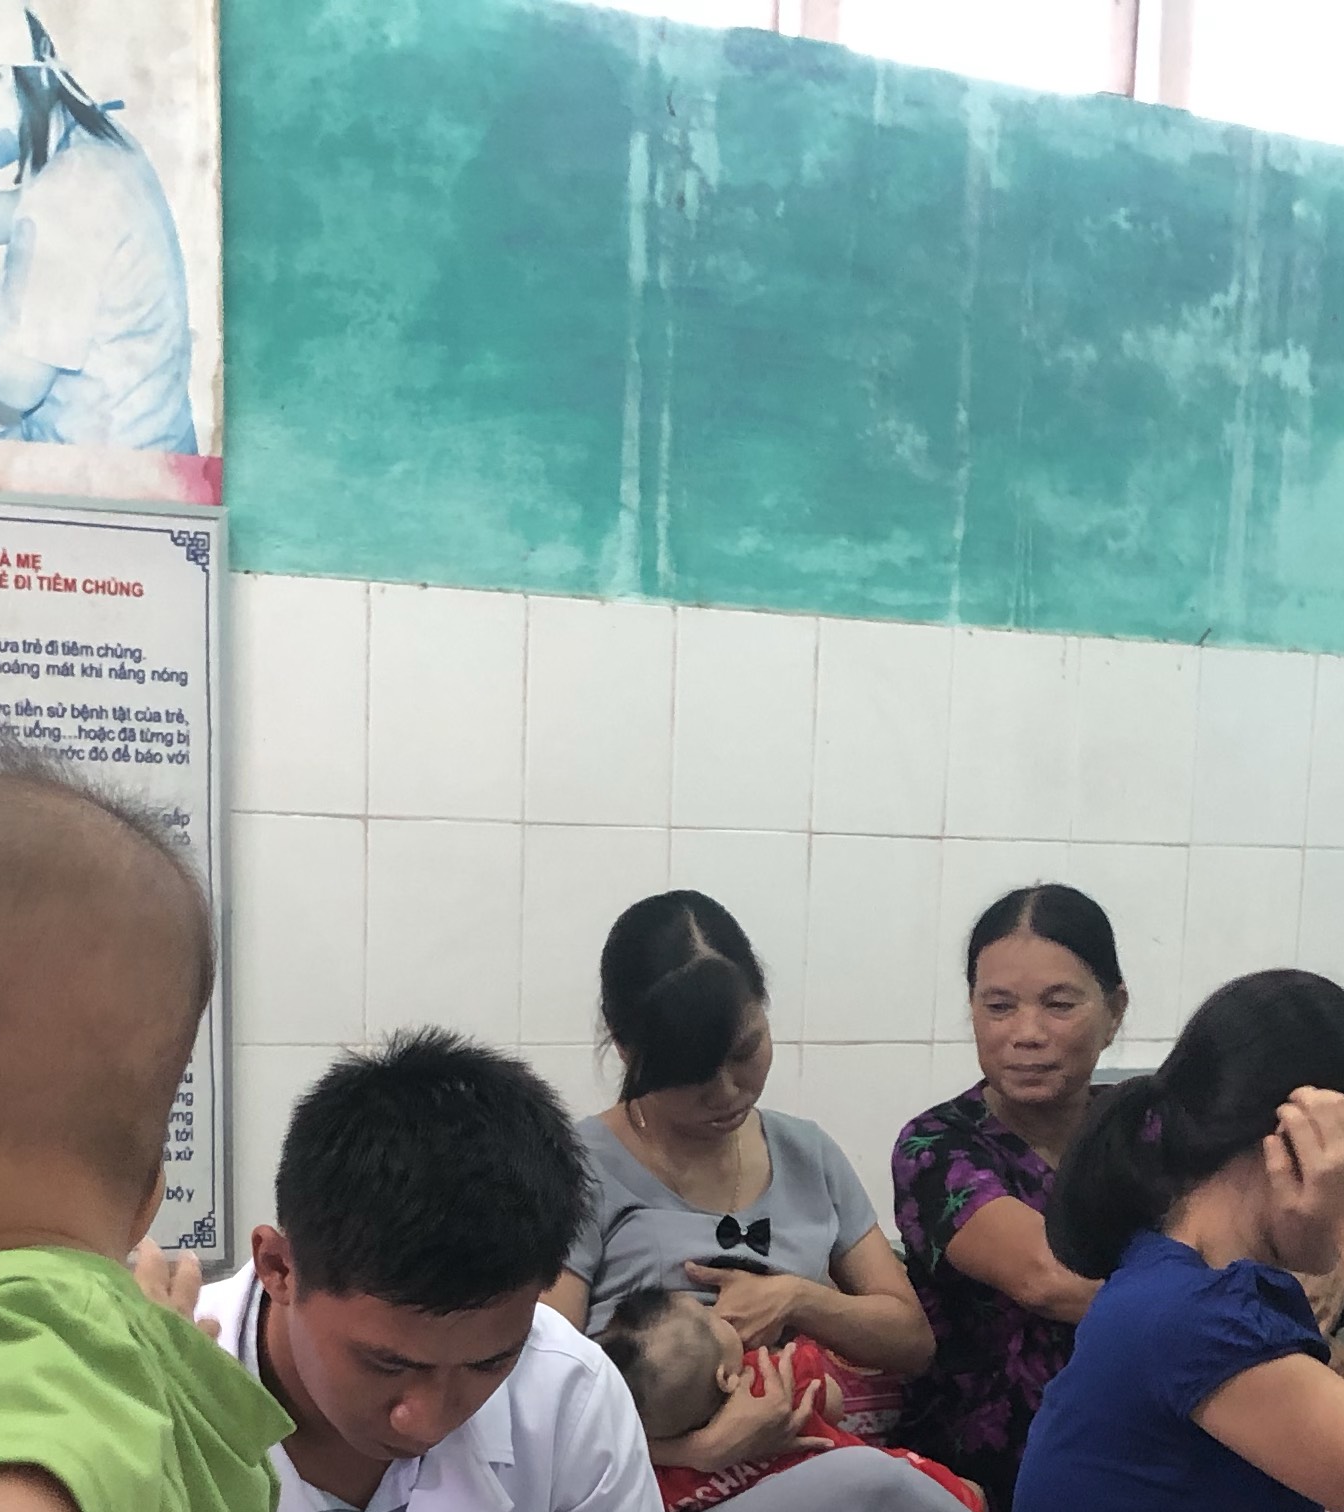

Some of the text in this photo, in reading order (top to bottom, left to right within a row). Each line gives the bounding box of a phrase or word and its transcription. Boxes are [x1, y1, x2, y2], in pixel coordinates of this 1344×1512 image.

[16, 553, 42, 573] MẸ
[14, 574, 32, 591] ĐI
[37, 573, 77, 593] TIÊM
[81, 662, 103, 678] khi
